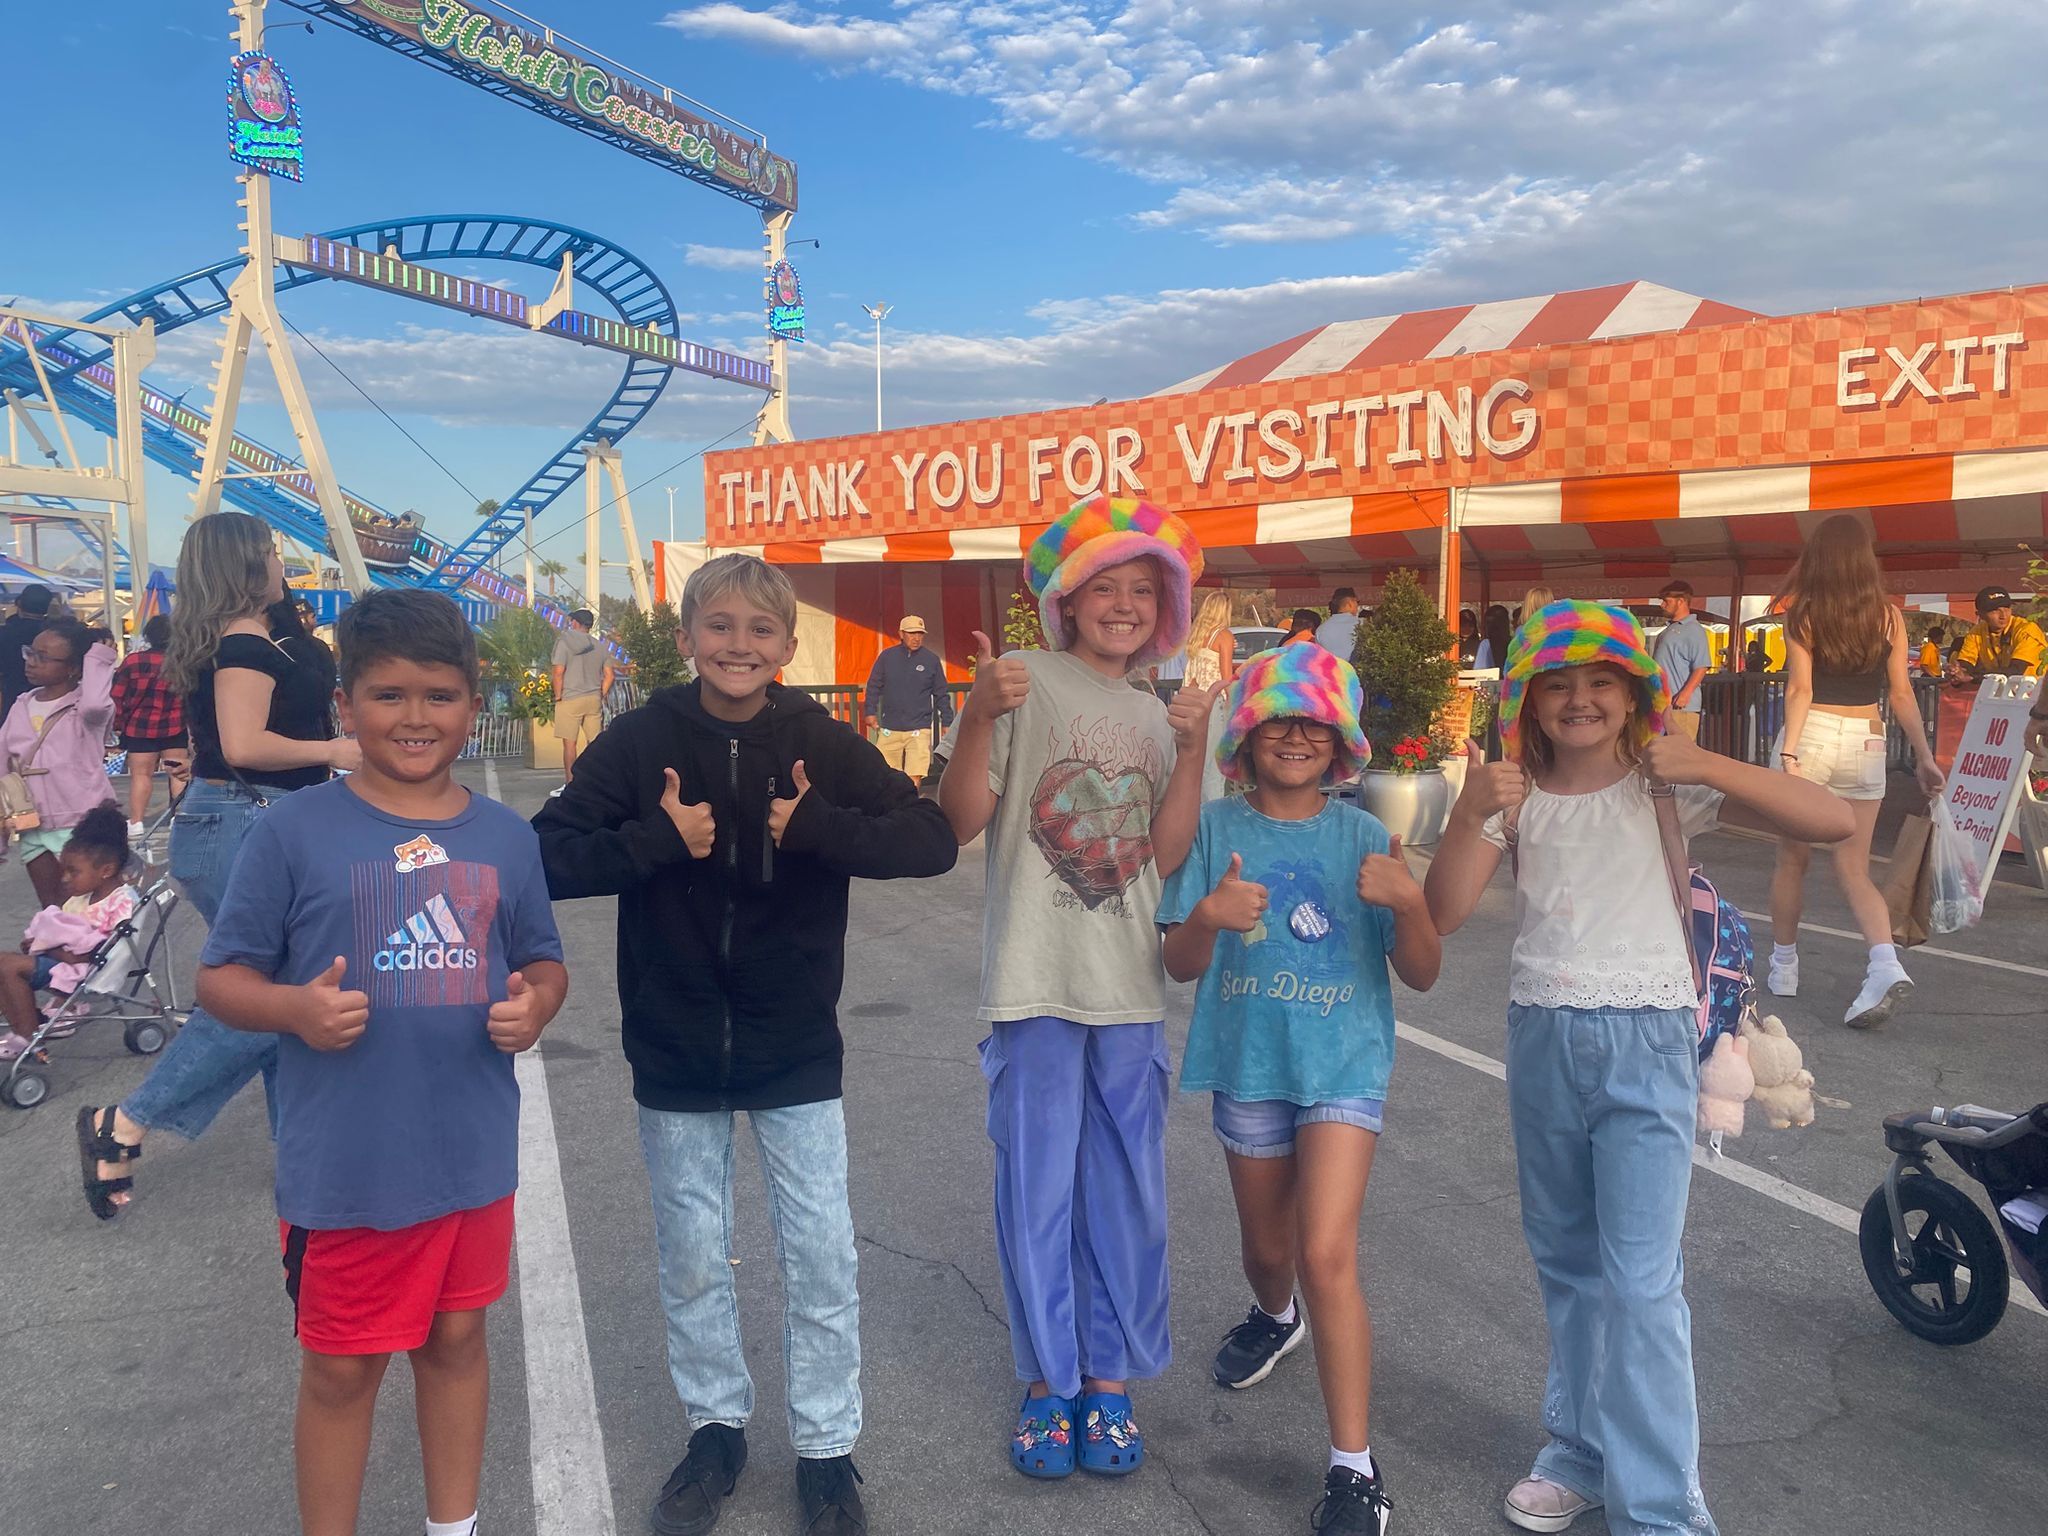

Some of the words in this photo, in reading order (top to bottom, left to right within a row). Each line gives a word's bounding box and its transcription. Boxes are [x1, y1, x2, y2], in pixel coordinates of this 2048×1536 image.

[421, 0, 569, 99] Heidi
[572, 58, 717, 172] Coaster
[719, 460, 870, 527] THANK
[892, 443, 1003, 511] YOU
[1028, 427, 1145, 503] FOR
[1174, 378, 1538, 485] VISITING
[1836, 332, 2025, 408] EXIT
[1985, 718, 2009, 746] NO
[1959, 752, 2012, 781] ALCOHOL
[1952, 784, 2001, 811] Beyond
[373, 942, 477, 972] adidas
[1221, 970, 1260, 1001] San
[1267, 971, 1355, 1017] Diego
